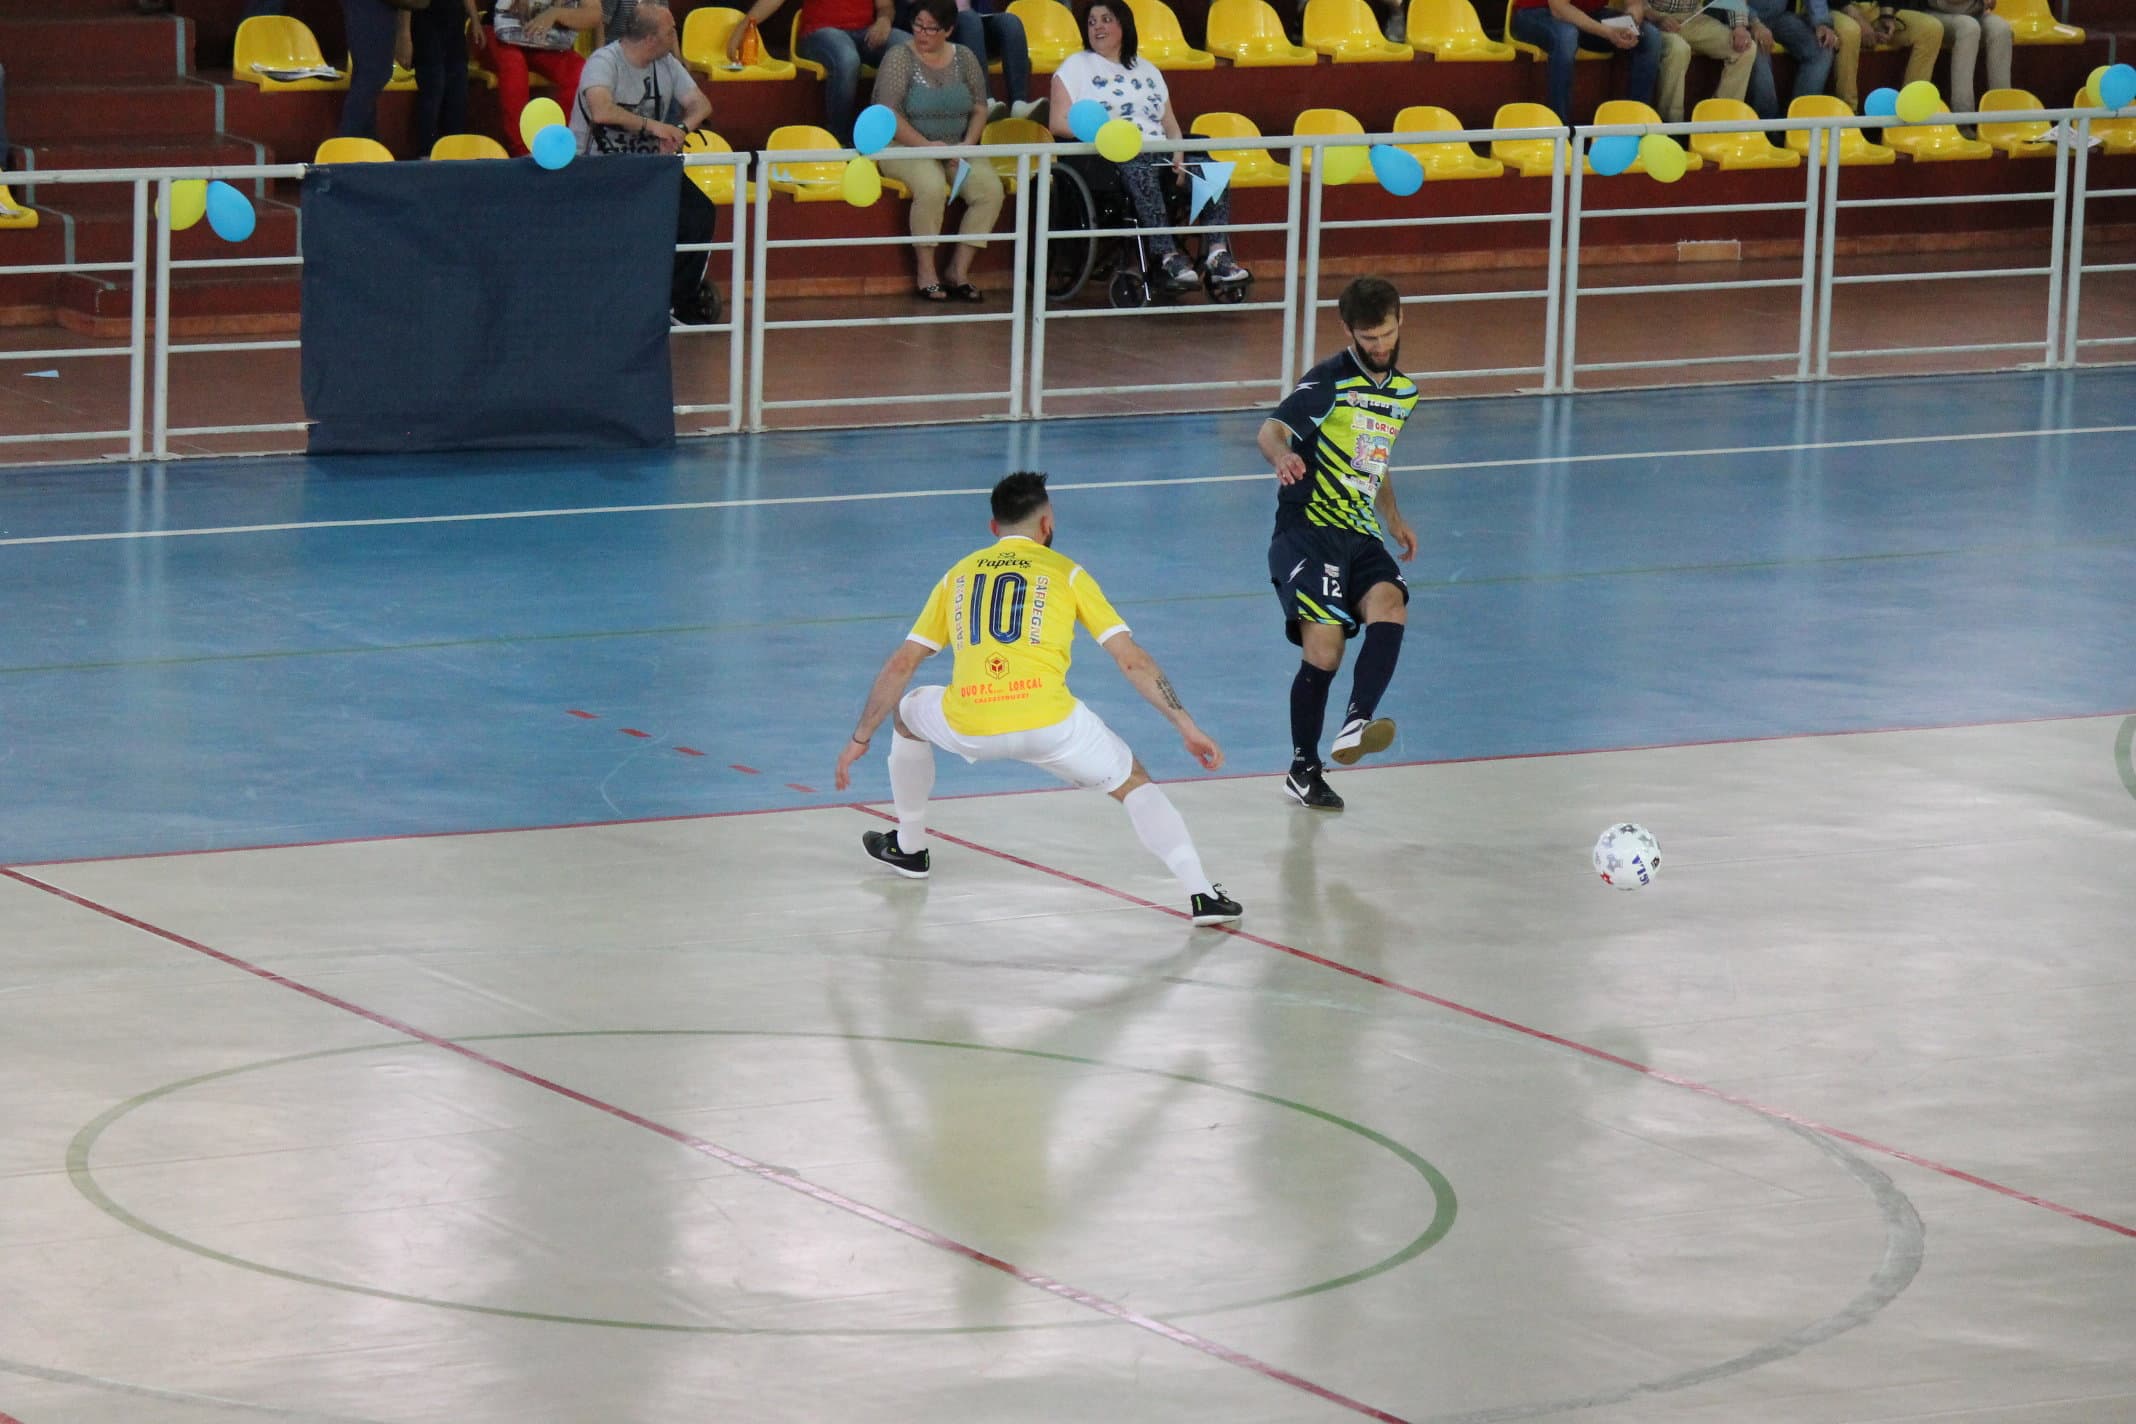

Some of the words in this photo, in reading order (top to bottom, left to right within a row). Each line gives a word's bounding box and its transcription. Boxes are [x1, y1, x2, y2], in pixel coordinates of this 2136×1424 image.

[970, 572, 1028, 645] 10
[1030, 576, 1049, 645] SARDEGNA
[1322, 576, 1343, 598] 12
